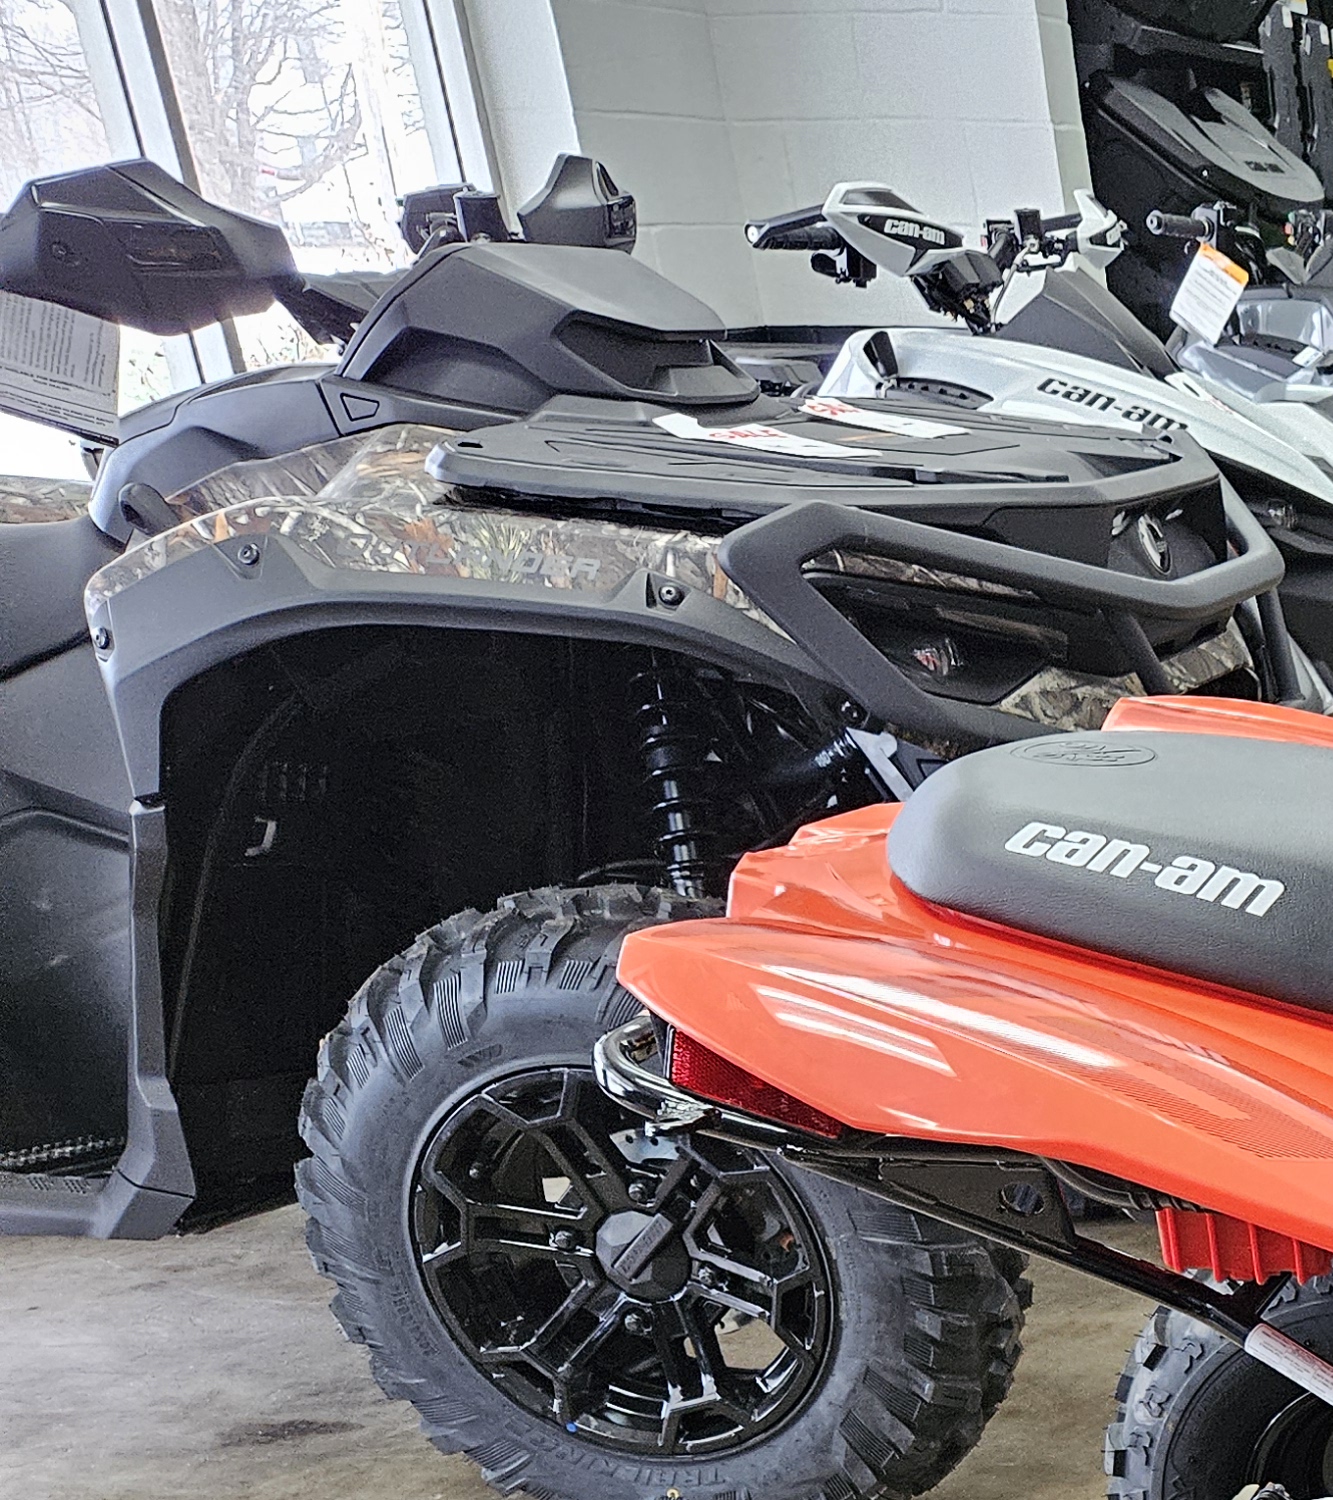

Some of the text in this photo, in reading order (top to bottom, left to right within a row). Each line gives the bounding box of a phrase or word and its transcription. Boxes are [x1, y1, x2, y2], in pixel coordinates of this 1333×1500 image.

[884, 217, 945, 246] can-am
[1037, 377, 1188, 431] can-am
[1004, 821, 1285, 918] can-am
